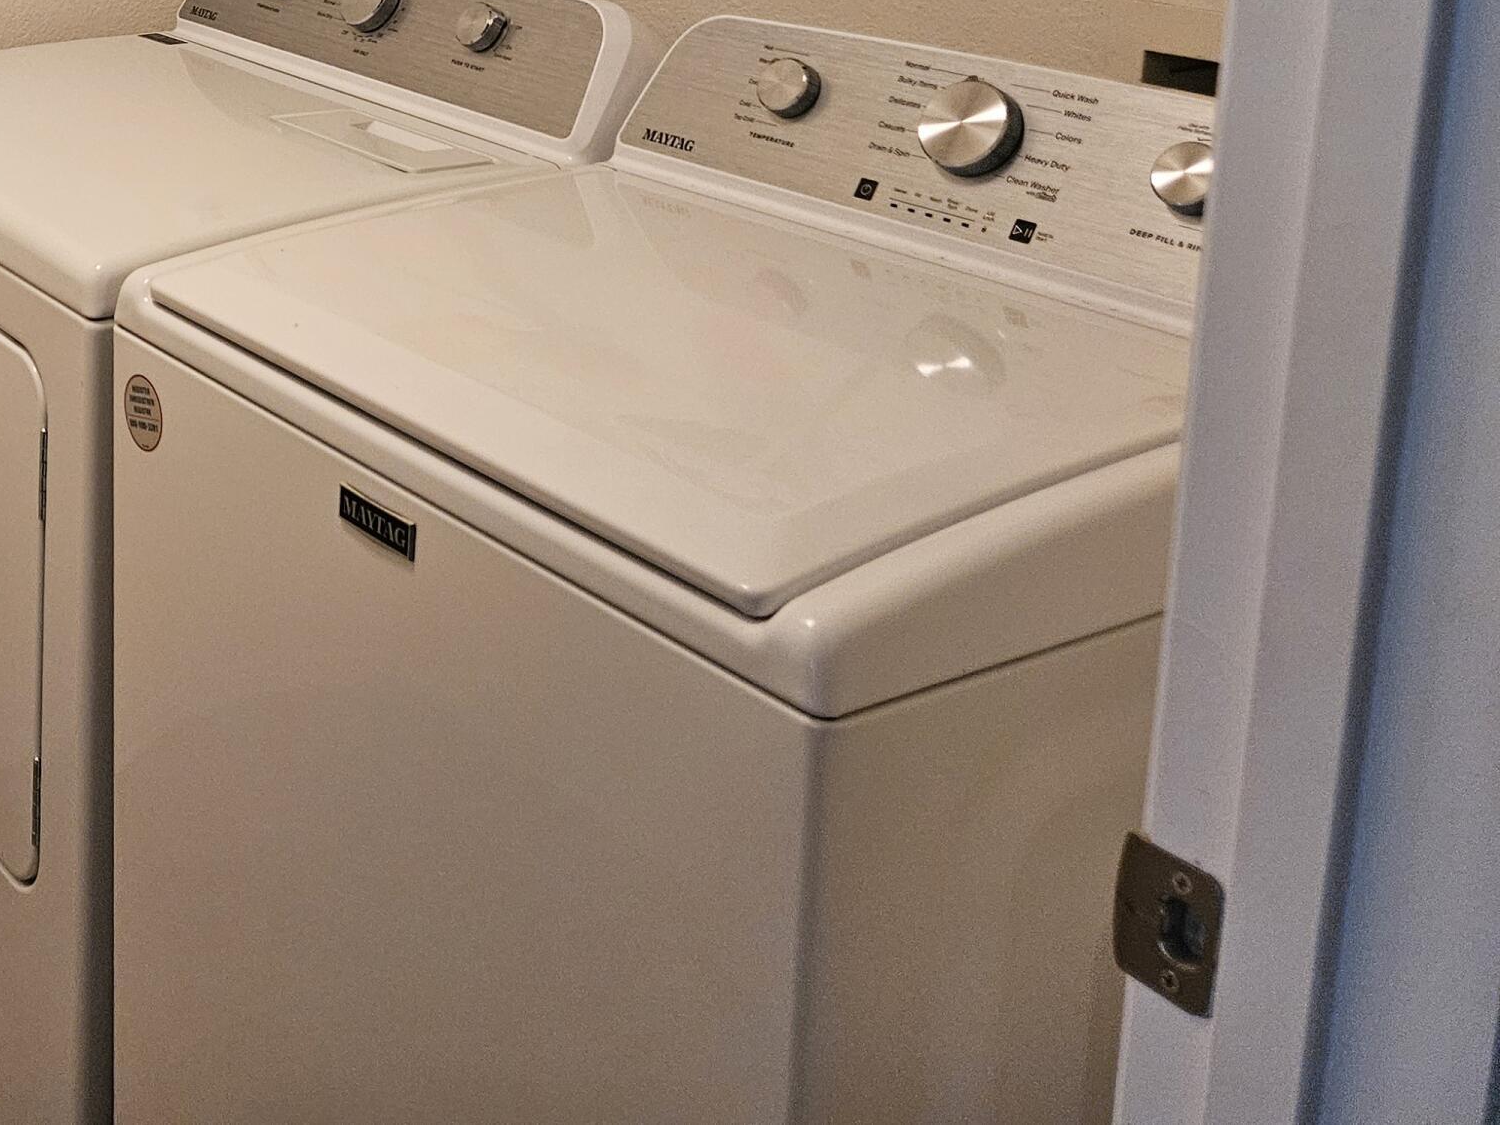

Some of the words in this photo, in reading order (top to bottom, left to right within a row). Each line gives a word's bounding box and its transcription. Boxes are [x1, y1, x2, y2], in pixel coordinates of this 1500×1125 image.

[190, 5, 218, 21] MAYTAG
[1052, 89, 1075, 101] Quick
[1076, 92, 1099, 105] Wash
[1063, 109, 1092, 122] Whites
[641, 128, 696, 152] MAYTAG
[1055, 132, 1083, 145] Colors
[1024, 155, 1049, 168] Heavy
[1050, 160, 1071, 173] Duty
[1006, 175, 1029, 186] Clean
[1030, 181, 1060, 194] Washer
[1129, 228, 1153, 239] DEEP
[1155, 235, 1174, 247] FILL
[342, 495, 408, 549] MAYTAG
